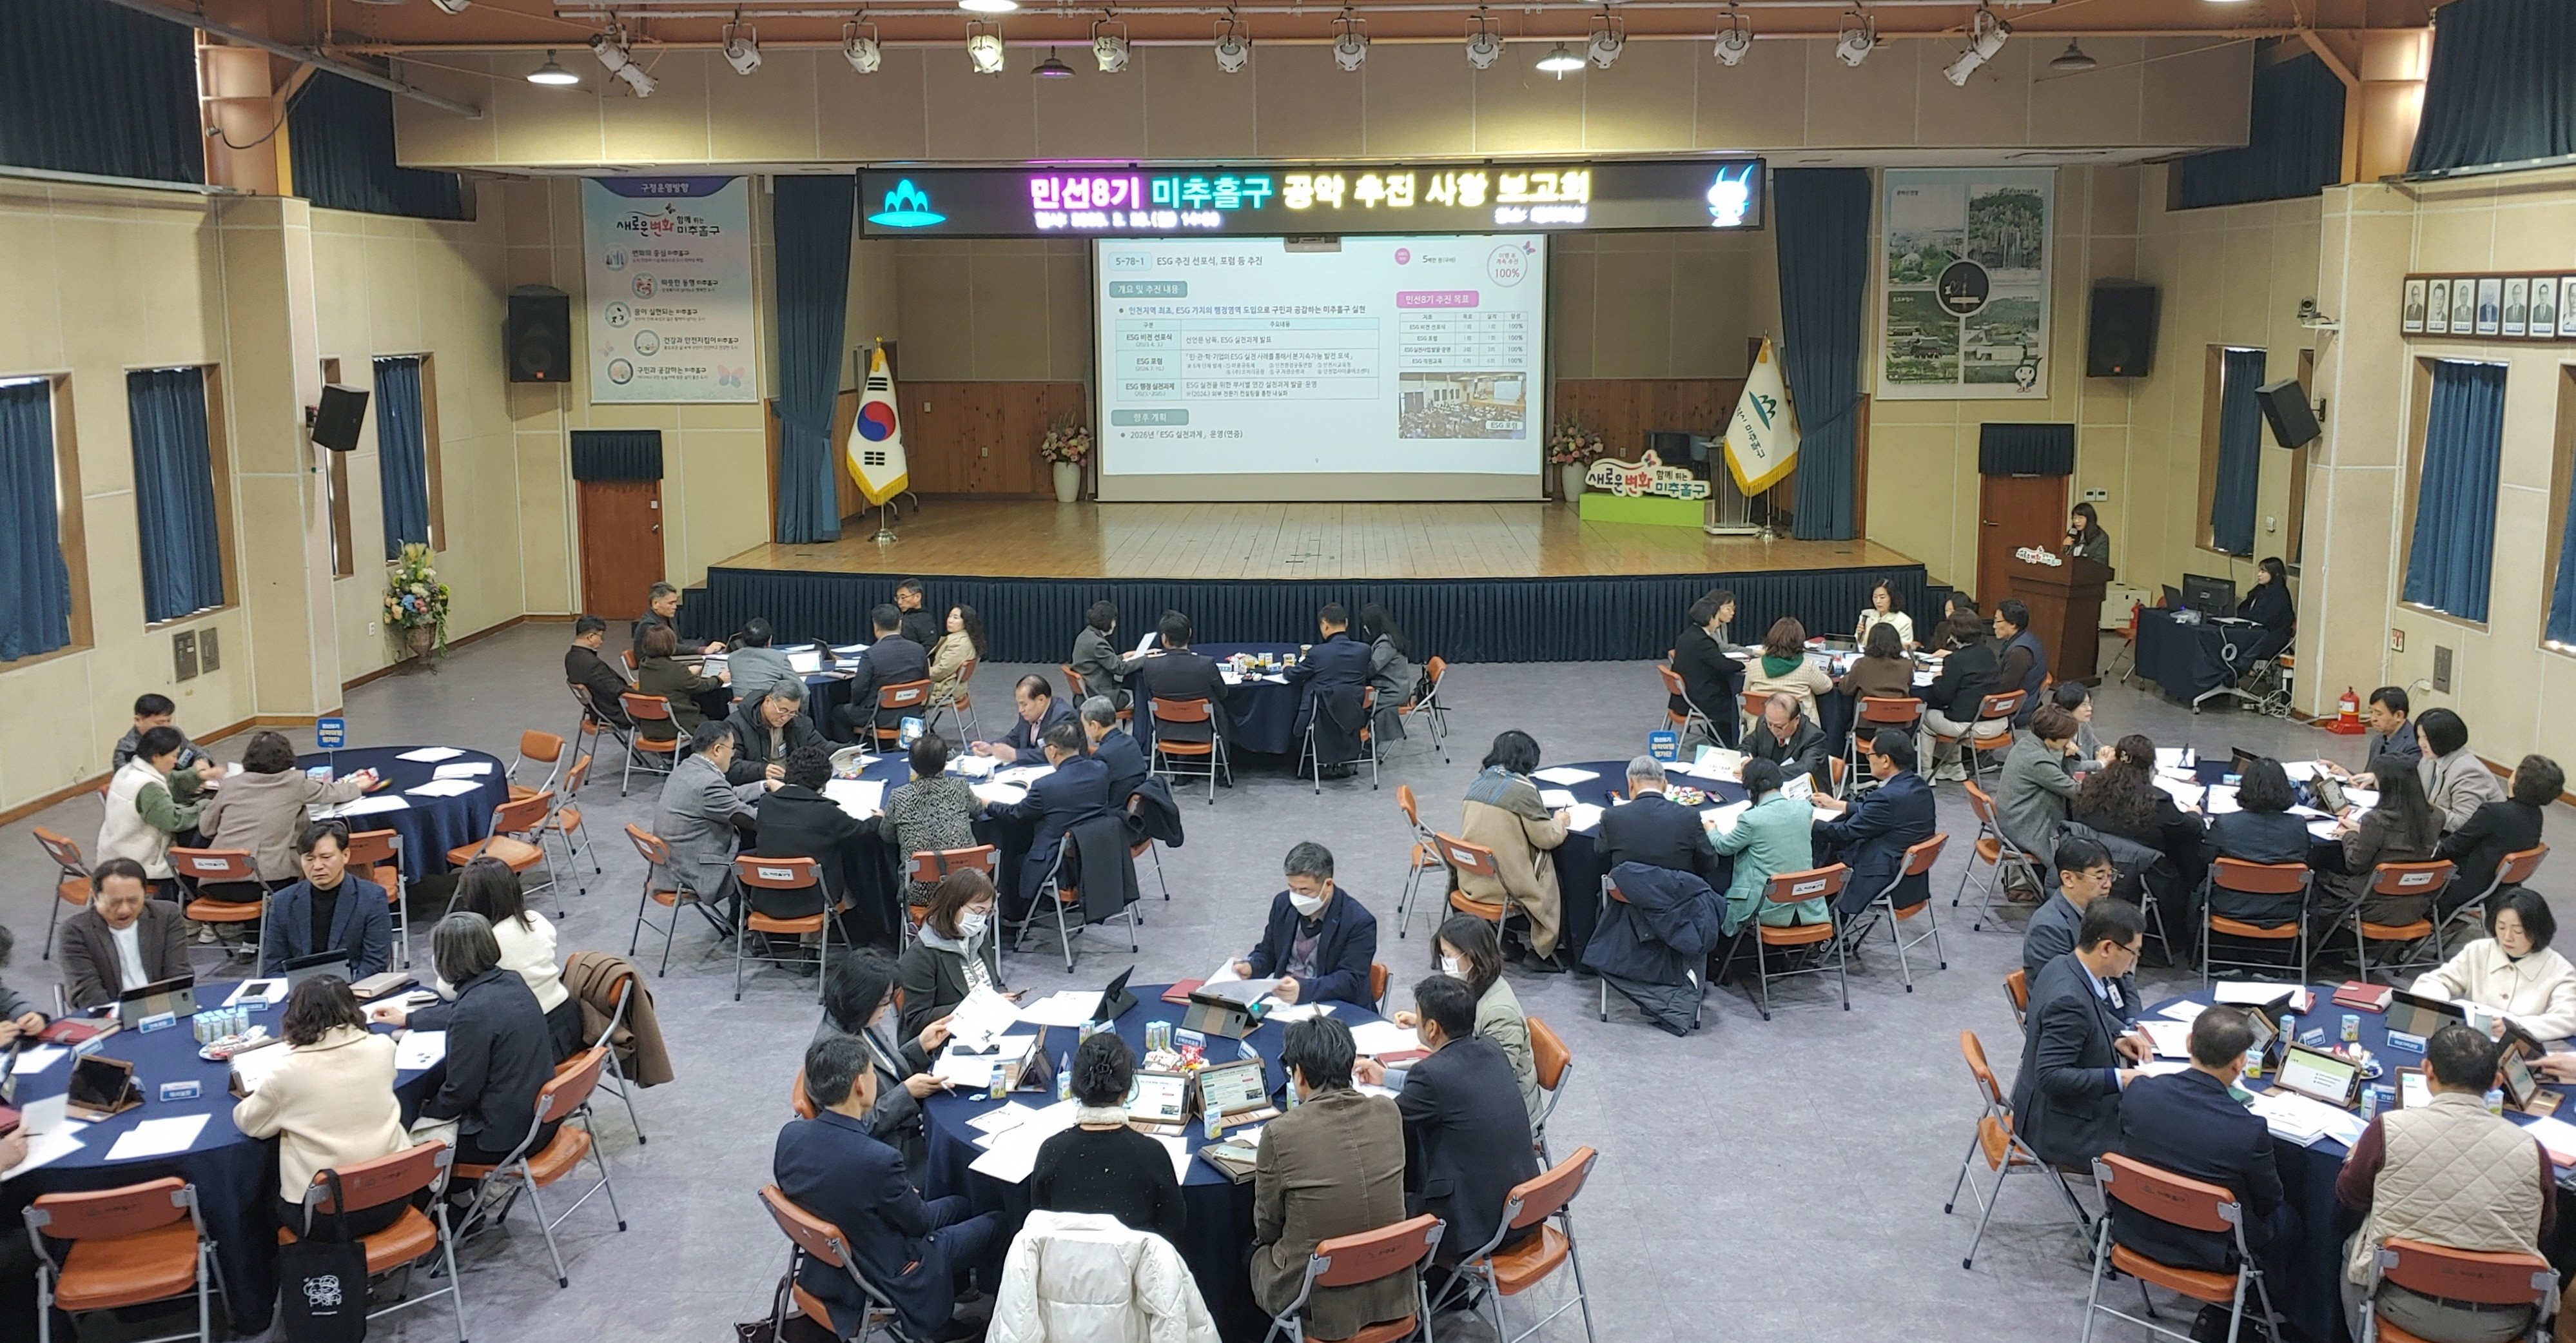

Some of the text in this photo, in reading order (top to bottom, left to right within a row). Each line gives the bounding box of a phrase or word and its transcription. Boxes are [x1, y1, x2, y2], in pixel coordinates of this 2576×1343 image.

[641, 184, 689, 193] 구정운영방향
[1031, 177, 1140, 209] 민선8기
[1153, 177, 1273, 209] 미추홀구
[1283, 175, 1345, 209] 공약
[1354, 174, 1414, 208] 추진
[1496, 171, 1588, 204] 보고회
[617, 216, 674, 237] 새로운 변화
[678, 226, 720, 237] 미추홀구
[1116, 257, 1144, 266] 5-78-1
[1157, 256, 1262, 267] ESG 추진 선포식, 포럼 등 추진
[1495, 268, 1520, 278] 100%
[1118, 284, 1179, 294] 개요 및 추진 내용
[1405, 295, 1470, 304] 민선8기 추진 목표
[1129, 306, 1156, 315] 인천지역
[1243, 306, 1270, 314] 도입으로
[1272, 306, 1292, 314] 구민과
[1294, 306, 1321, 314] 공감하는
[1323, 306, 1350, 314] 미추홀구
[1352, 305, 1365, 313] 실현
[1133, 413, 1166, 422] 향후 계획
[1131, 431, 1155, 439] 2026년
[1209, 430, 1243, 439] 운영(연중)
[1745, 424, 1765, 458] 미추홀구
[1588, 467, 1653, 494] 새로운 변화
[1657, 470, 1688, 481] 함께 뛰는
[1655, 482, 1705, 496] 미추홀구
